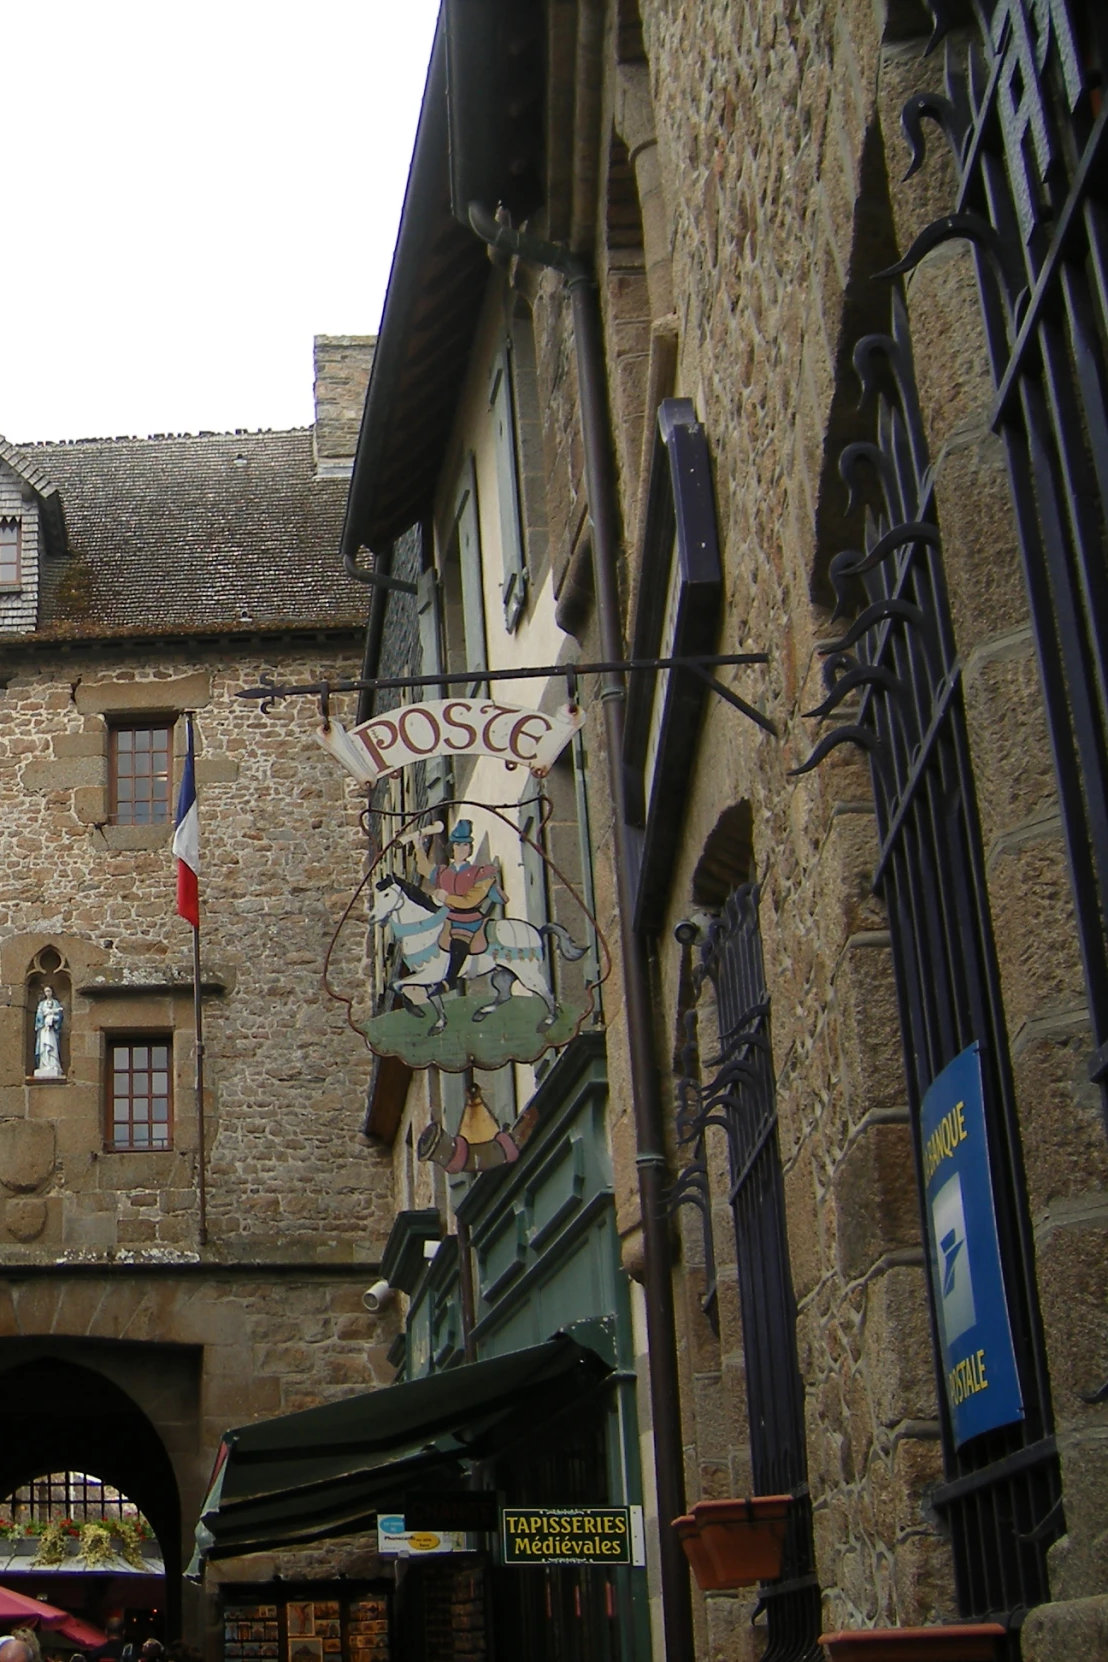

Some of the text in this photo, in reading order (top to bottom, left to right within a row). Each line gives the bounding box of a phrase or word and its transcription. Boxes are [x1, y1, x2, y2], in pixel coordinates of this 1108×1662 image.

[354, 702, 553, 773] POSTE
[506, 1516, 626, 1533] TAPISSERIES
[515, 1535, 621, 1555] Médiévales
